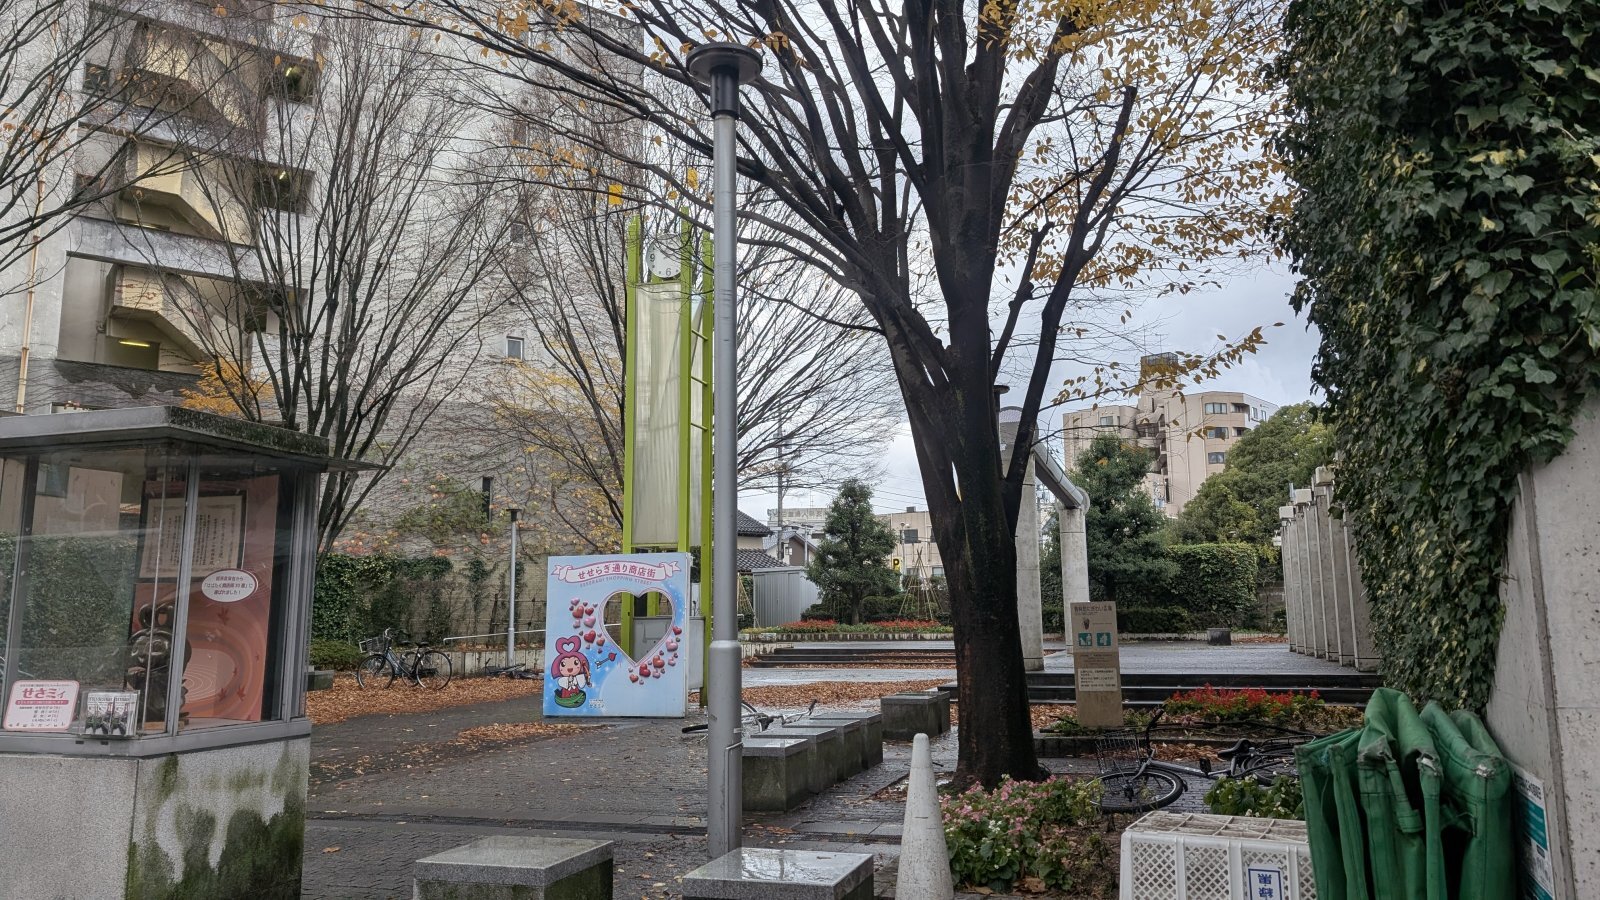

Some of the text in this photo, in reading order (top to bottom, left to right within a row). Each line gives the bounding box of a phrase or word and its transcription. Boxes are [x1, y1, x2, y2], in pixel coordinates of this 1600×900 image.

[893, 558, 900, 569] P
[578, 563, 656, 579] せせらぎ通り商店街
